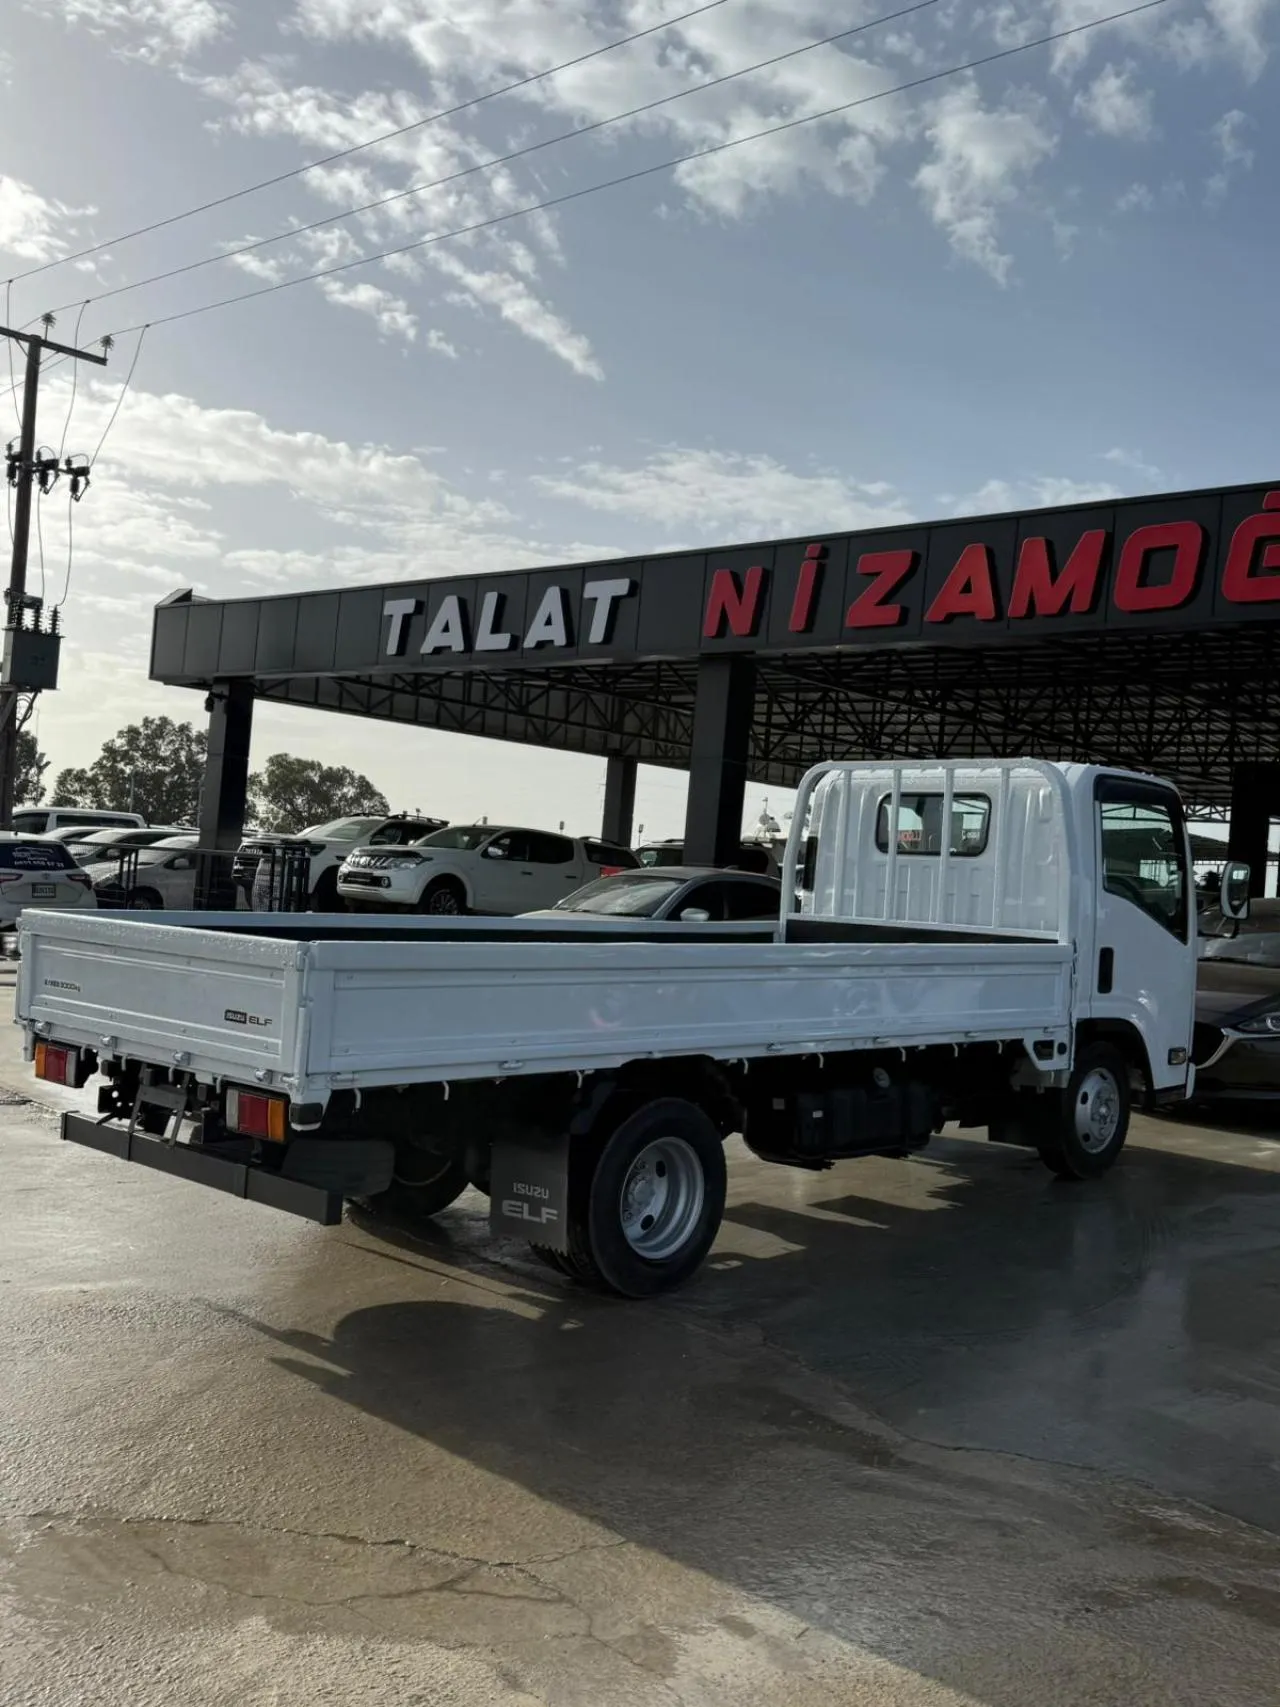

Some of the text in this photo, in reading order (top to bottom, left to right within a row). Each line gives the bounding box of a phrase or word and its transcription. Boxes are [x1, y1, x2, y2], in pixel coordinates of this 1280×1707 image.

[383, 578, 630, 656] TALAT
[249, 1015, 273, 1026] ELF
[513, 1182, 549, 1199] ISUZU
[502, 1199, 558, 1224] ELF
